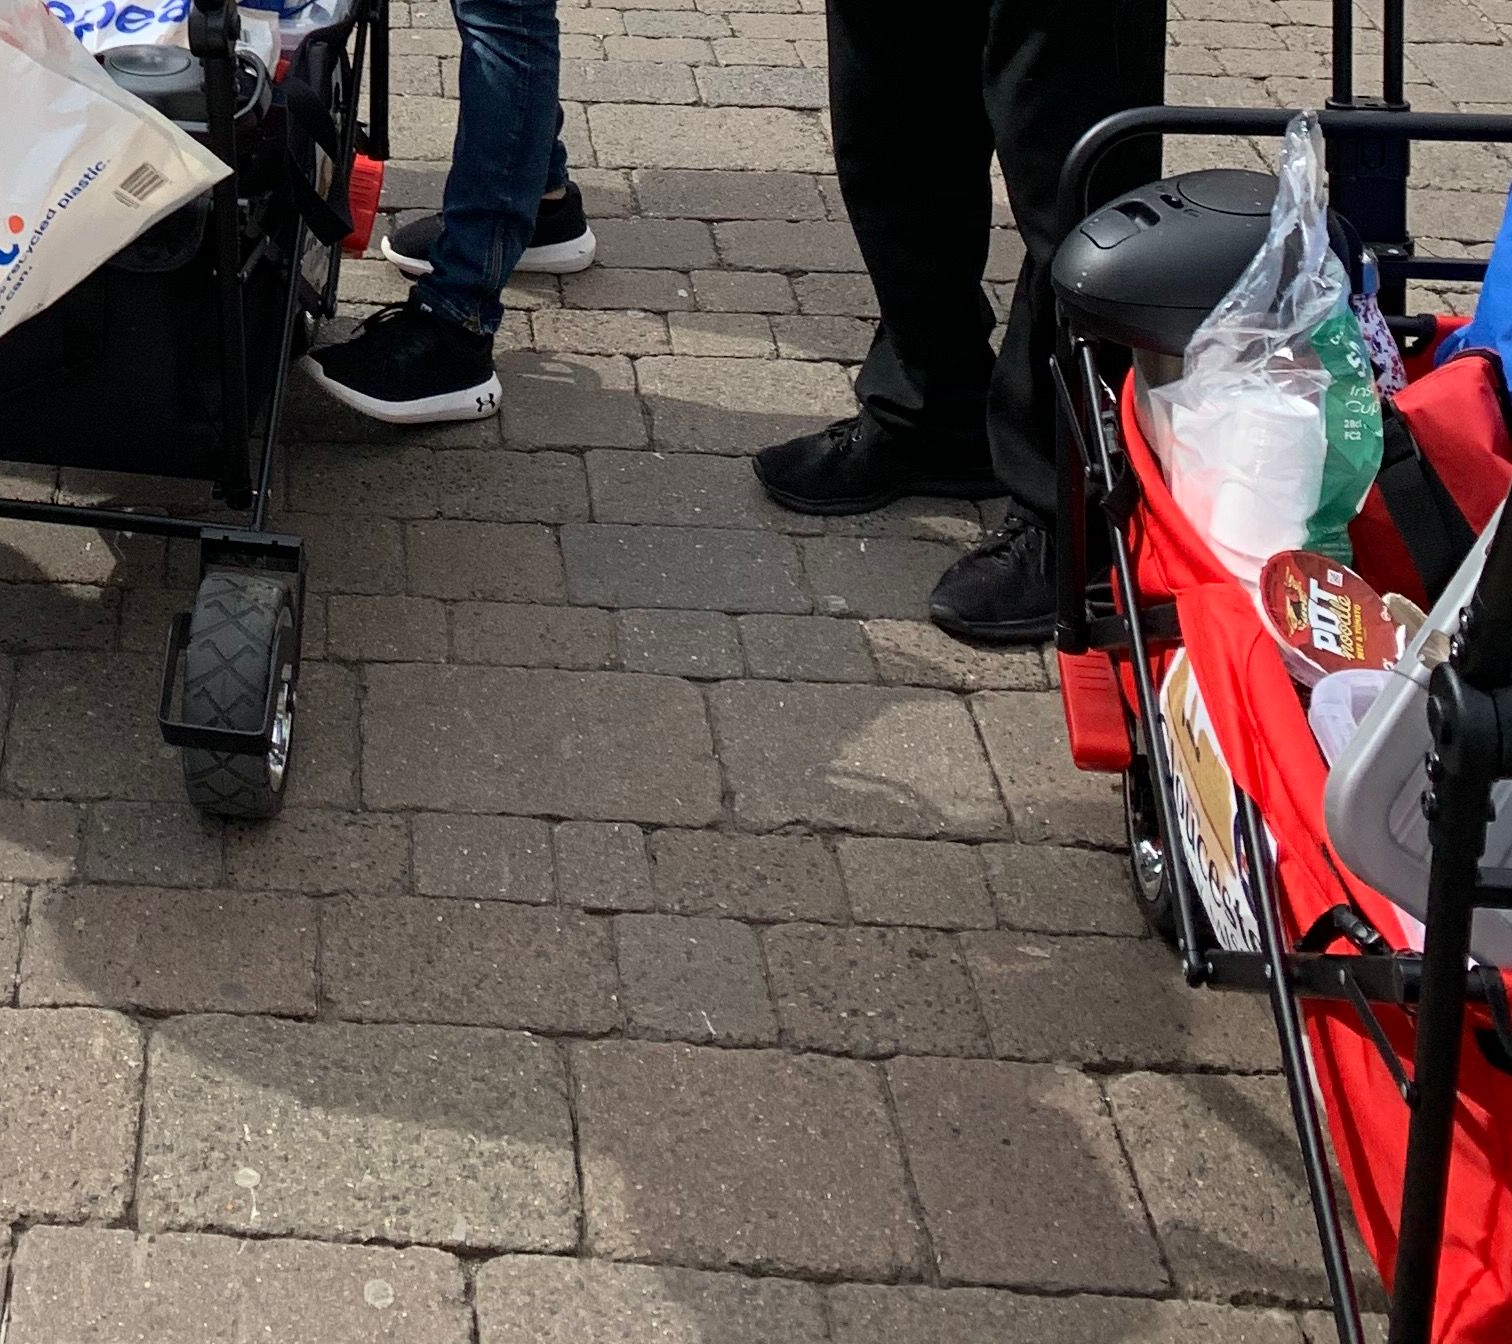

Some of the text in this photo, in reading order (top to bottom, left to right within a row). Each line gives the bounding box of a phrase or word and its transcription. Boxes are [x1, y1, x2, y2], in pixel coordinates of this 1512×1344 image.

[6, 208, 57, 283] recycled
[57, 159, 111, 210] plastic.
[6, 265, 33, 302] can.
[1308, 577, 1346, 658] POT
[1328, 594, 1356, 661] noodle
